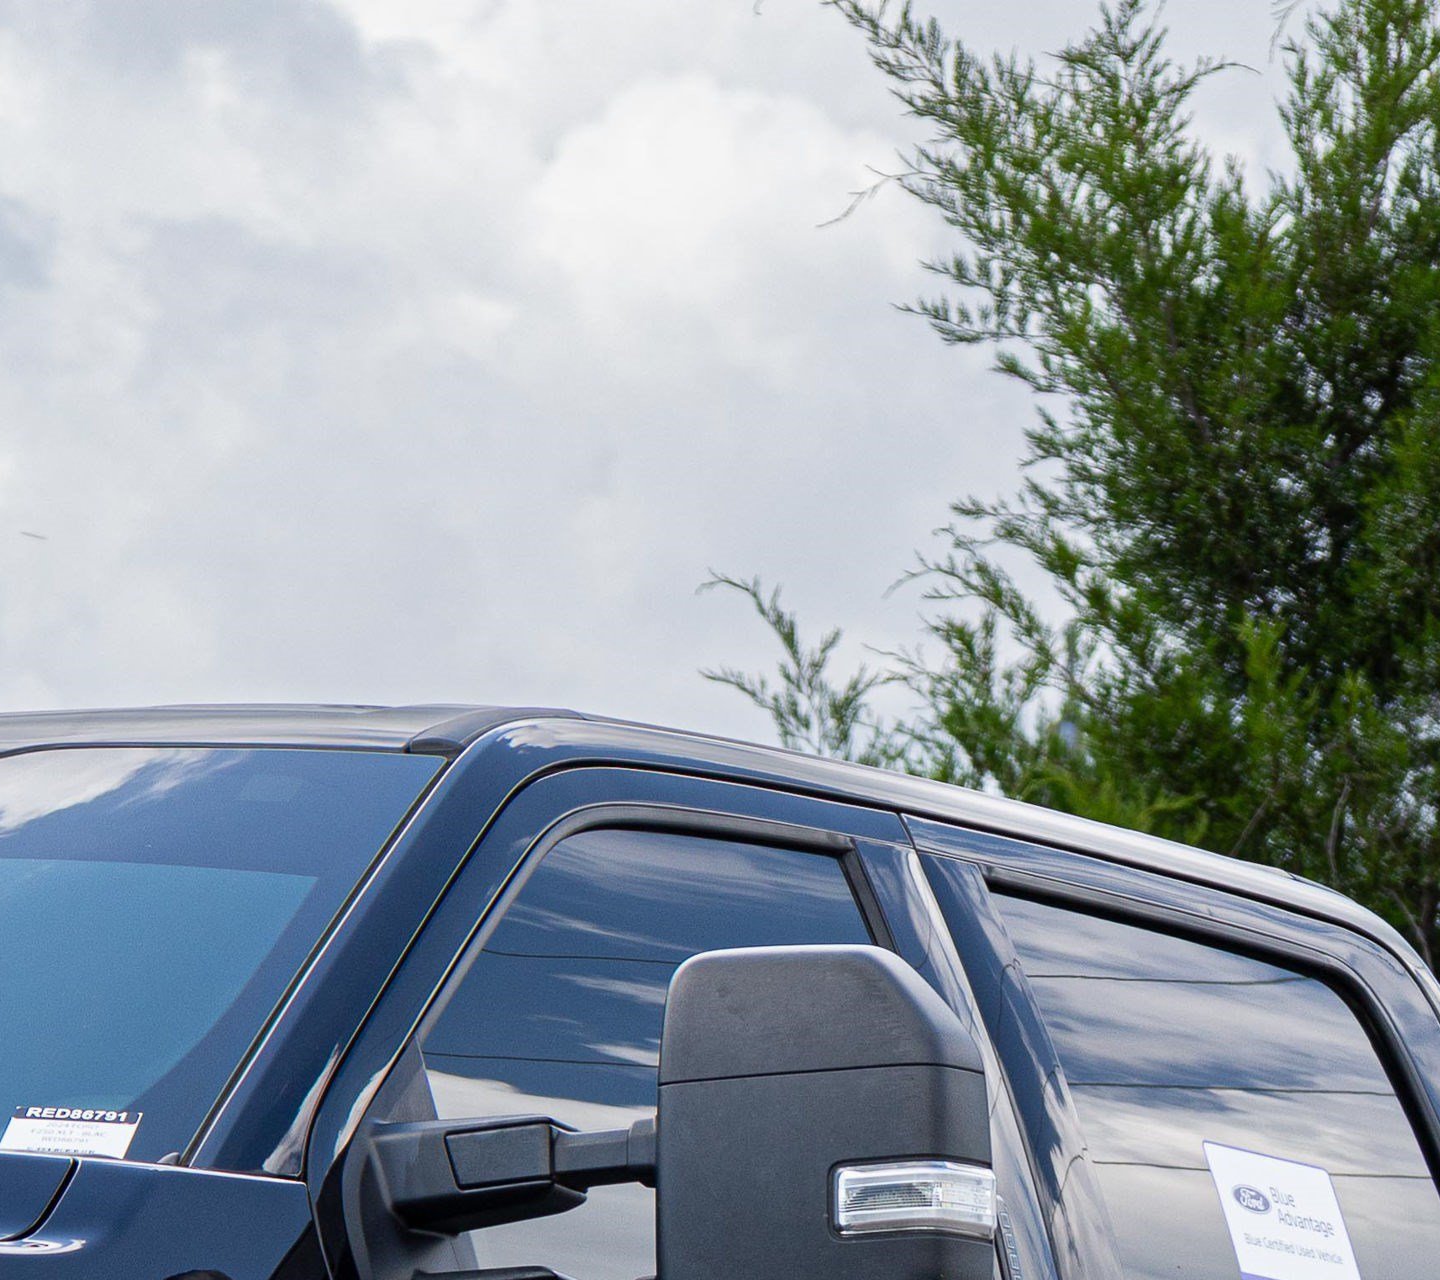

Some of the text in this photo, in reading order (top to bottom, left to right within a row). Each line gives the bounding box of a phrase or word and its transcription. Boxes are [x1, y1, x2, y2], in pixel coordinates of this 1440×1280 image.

[25, 1106, 128, 1122] RED86791
[1239, 1188, 1265, 1211] Ford
[1269, 1186, 1296, 1207] Blue
[1277, 1209, 1336, 1237] Advantage
